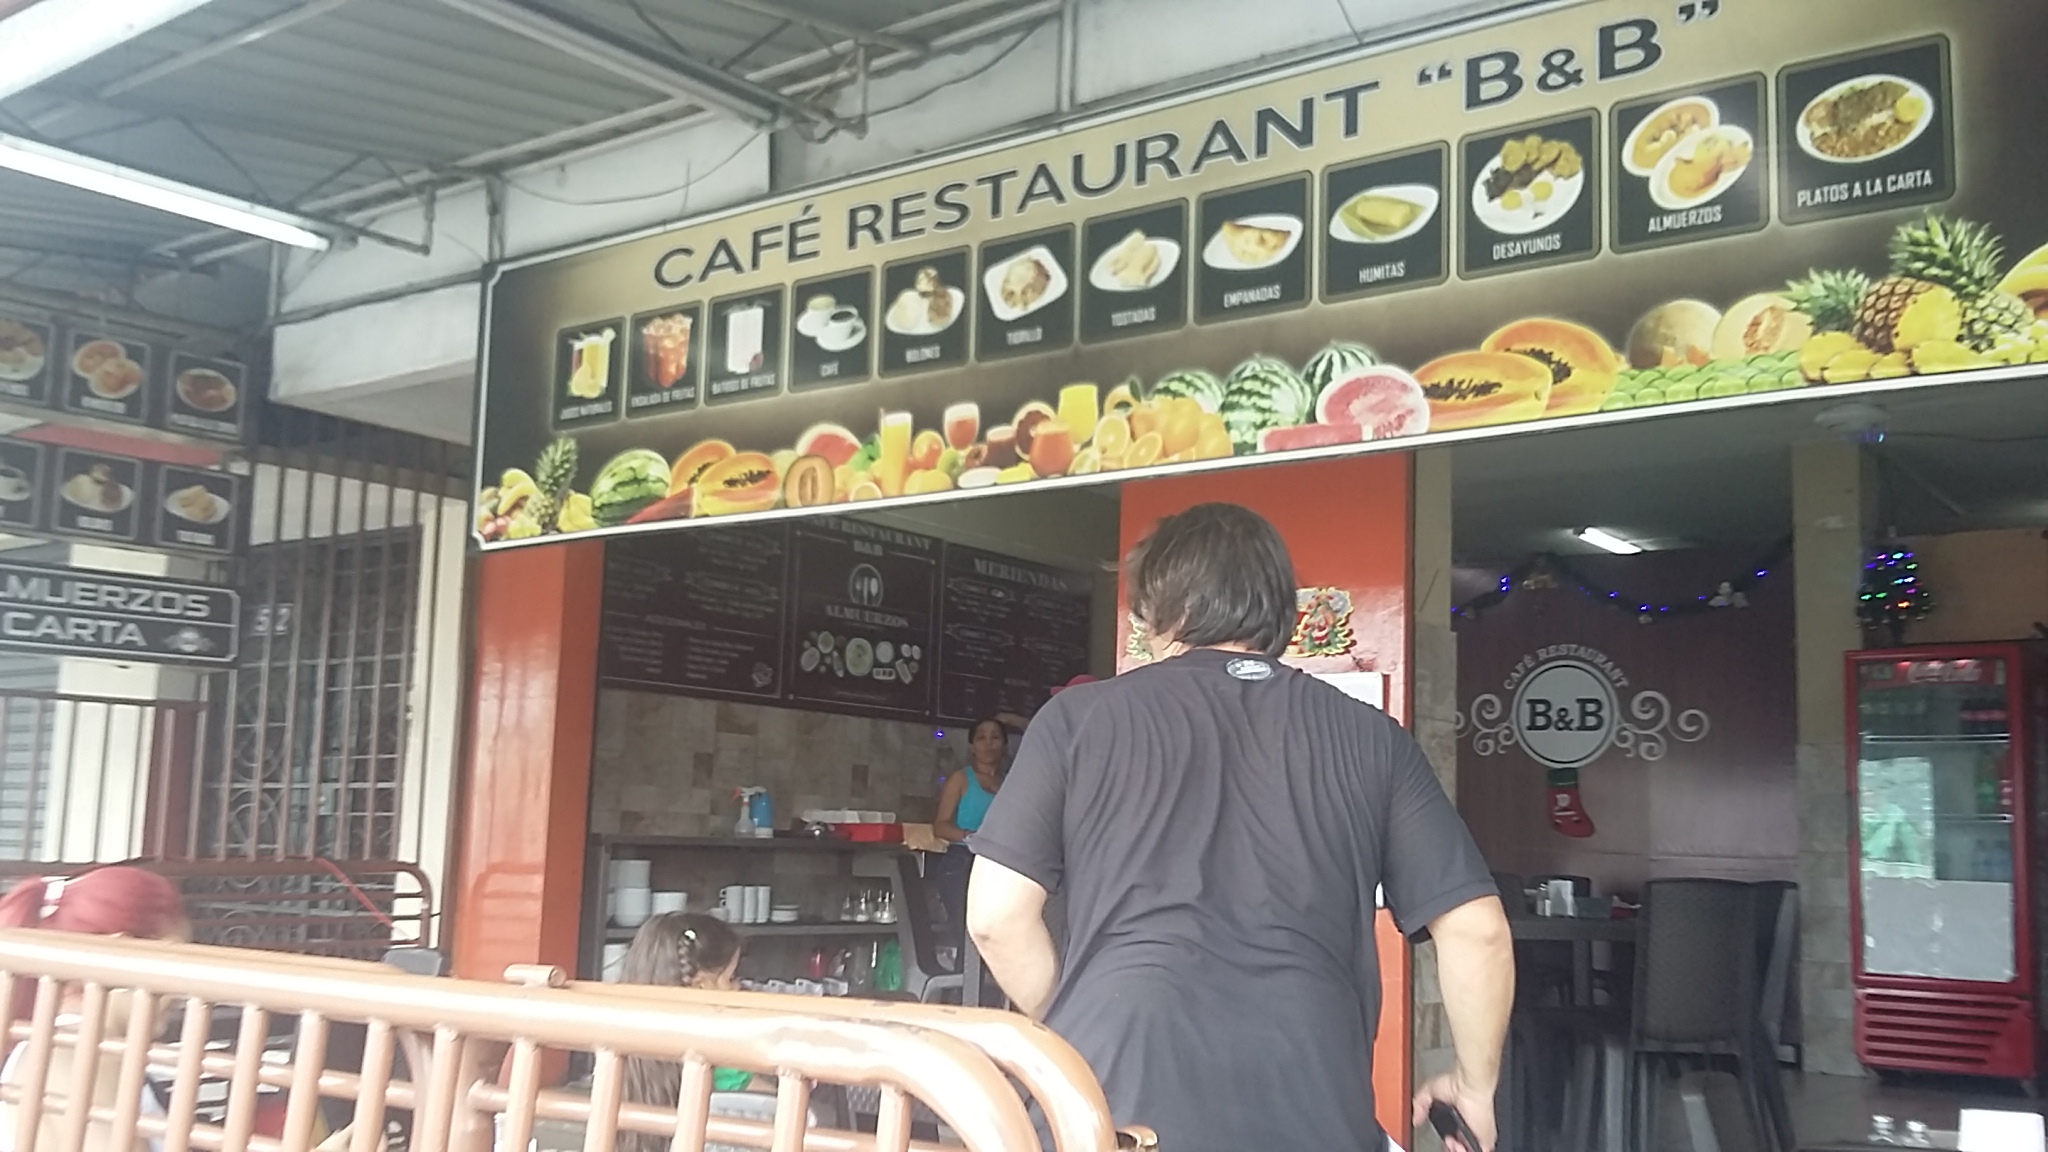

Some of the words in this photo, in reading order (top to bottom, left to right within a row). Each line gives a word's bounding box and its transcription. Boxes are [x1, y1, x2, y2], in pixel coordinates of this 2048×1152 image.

[653, 205, 821, 290] CAFÉ
[847, 80, 1380, 250] RESTAURANT
[1797, 182, 1849, 207] PLATOS
[1852, 181, 1862, 199] A
[1865, 177, 1882, 196] LA
[1887, 169, 1933, 193] CARTA
[1647, 205, 1722, 233] ALMUERZOS
[1492, 233, 1562, 260] DESAYUNOS
[1359, 261, 1406, 283] HUMITAS
[1223, 284, 1281, 308] EMPANADAS
[2, 611, 148, 647] CARTA
[1535, 643, 1630, 689] RESTAURANT
[1525, 698, 1604, 732] B&B
